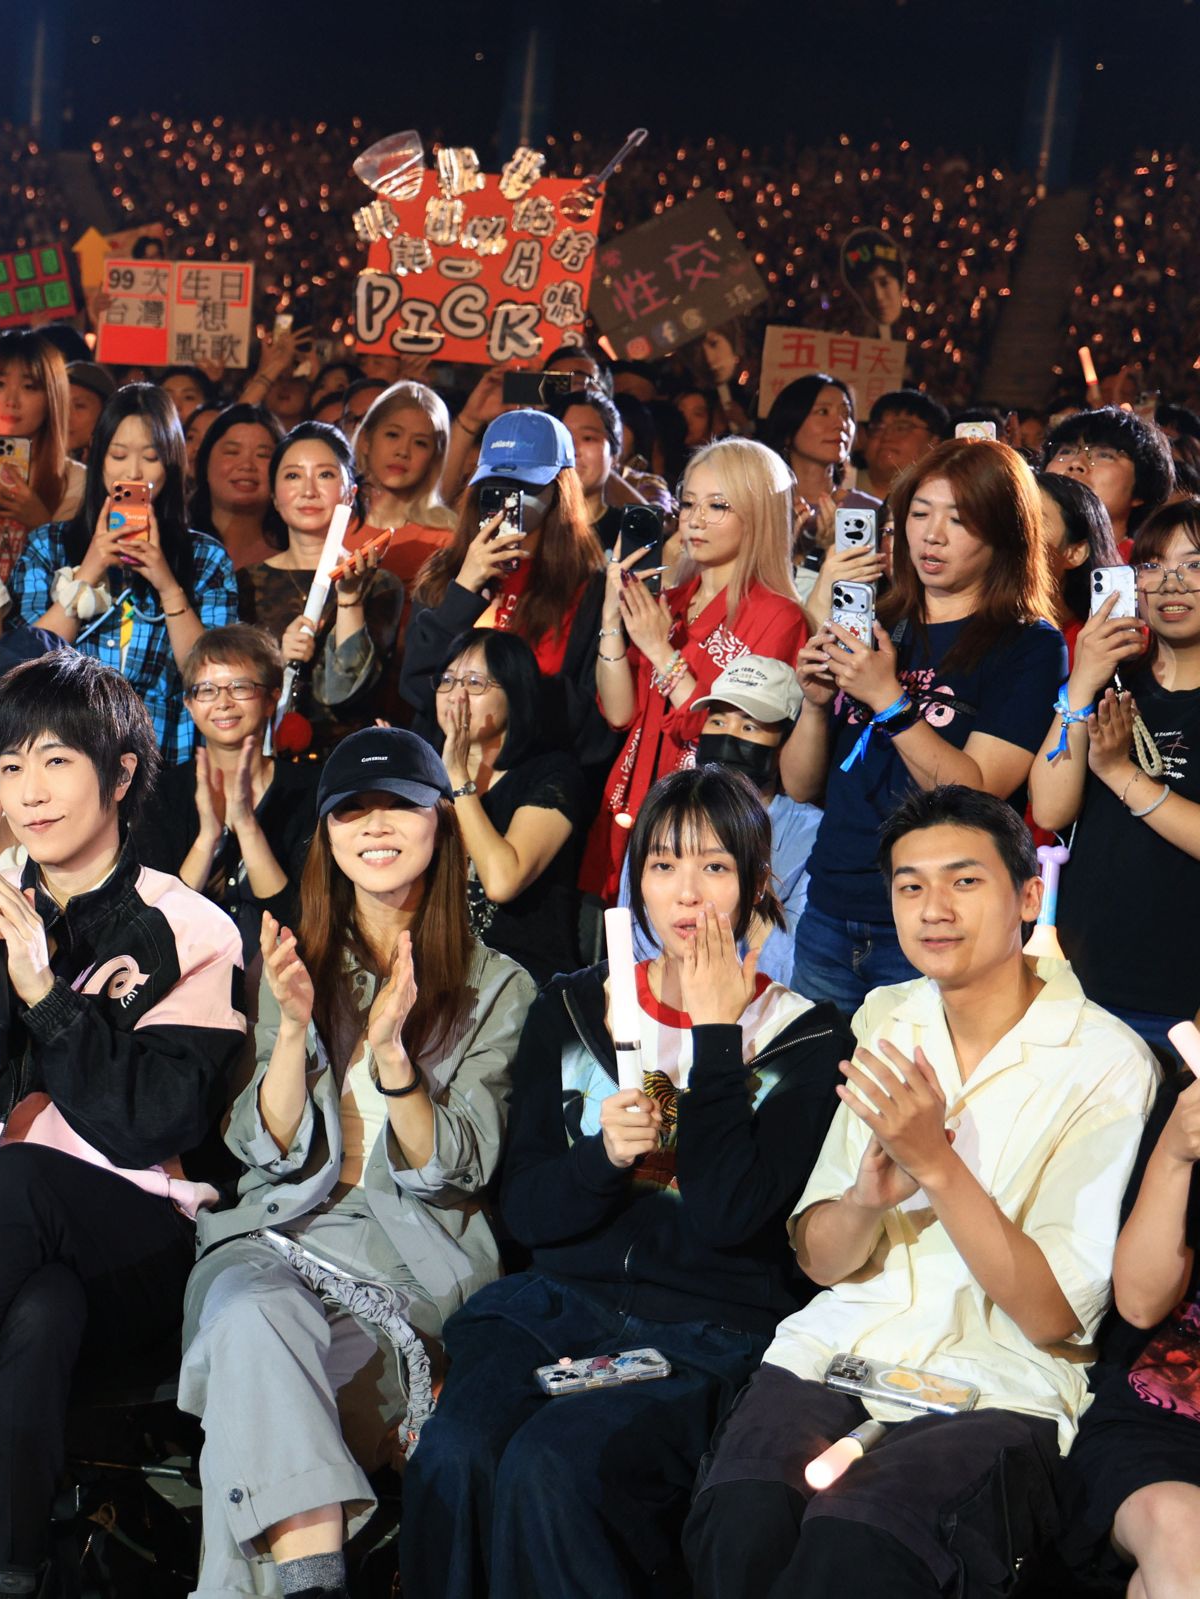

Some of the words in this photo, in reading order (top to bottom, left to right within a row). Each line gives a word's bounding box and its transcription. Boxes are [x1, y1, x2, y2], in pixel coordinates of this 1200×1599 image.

[182, 269, 243, 302] 生日
[197, 296, 228, 332] 想
[356, 272, 542, 362] PICK
[176, 332, 241, 364] 點歌
[777, 332, 898, 374] 五月天
